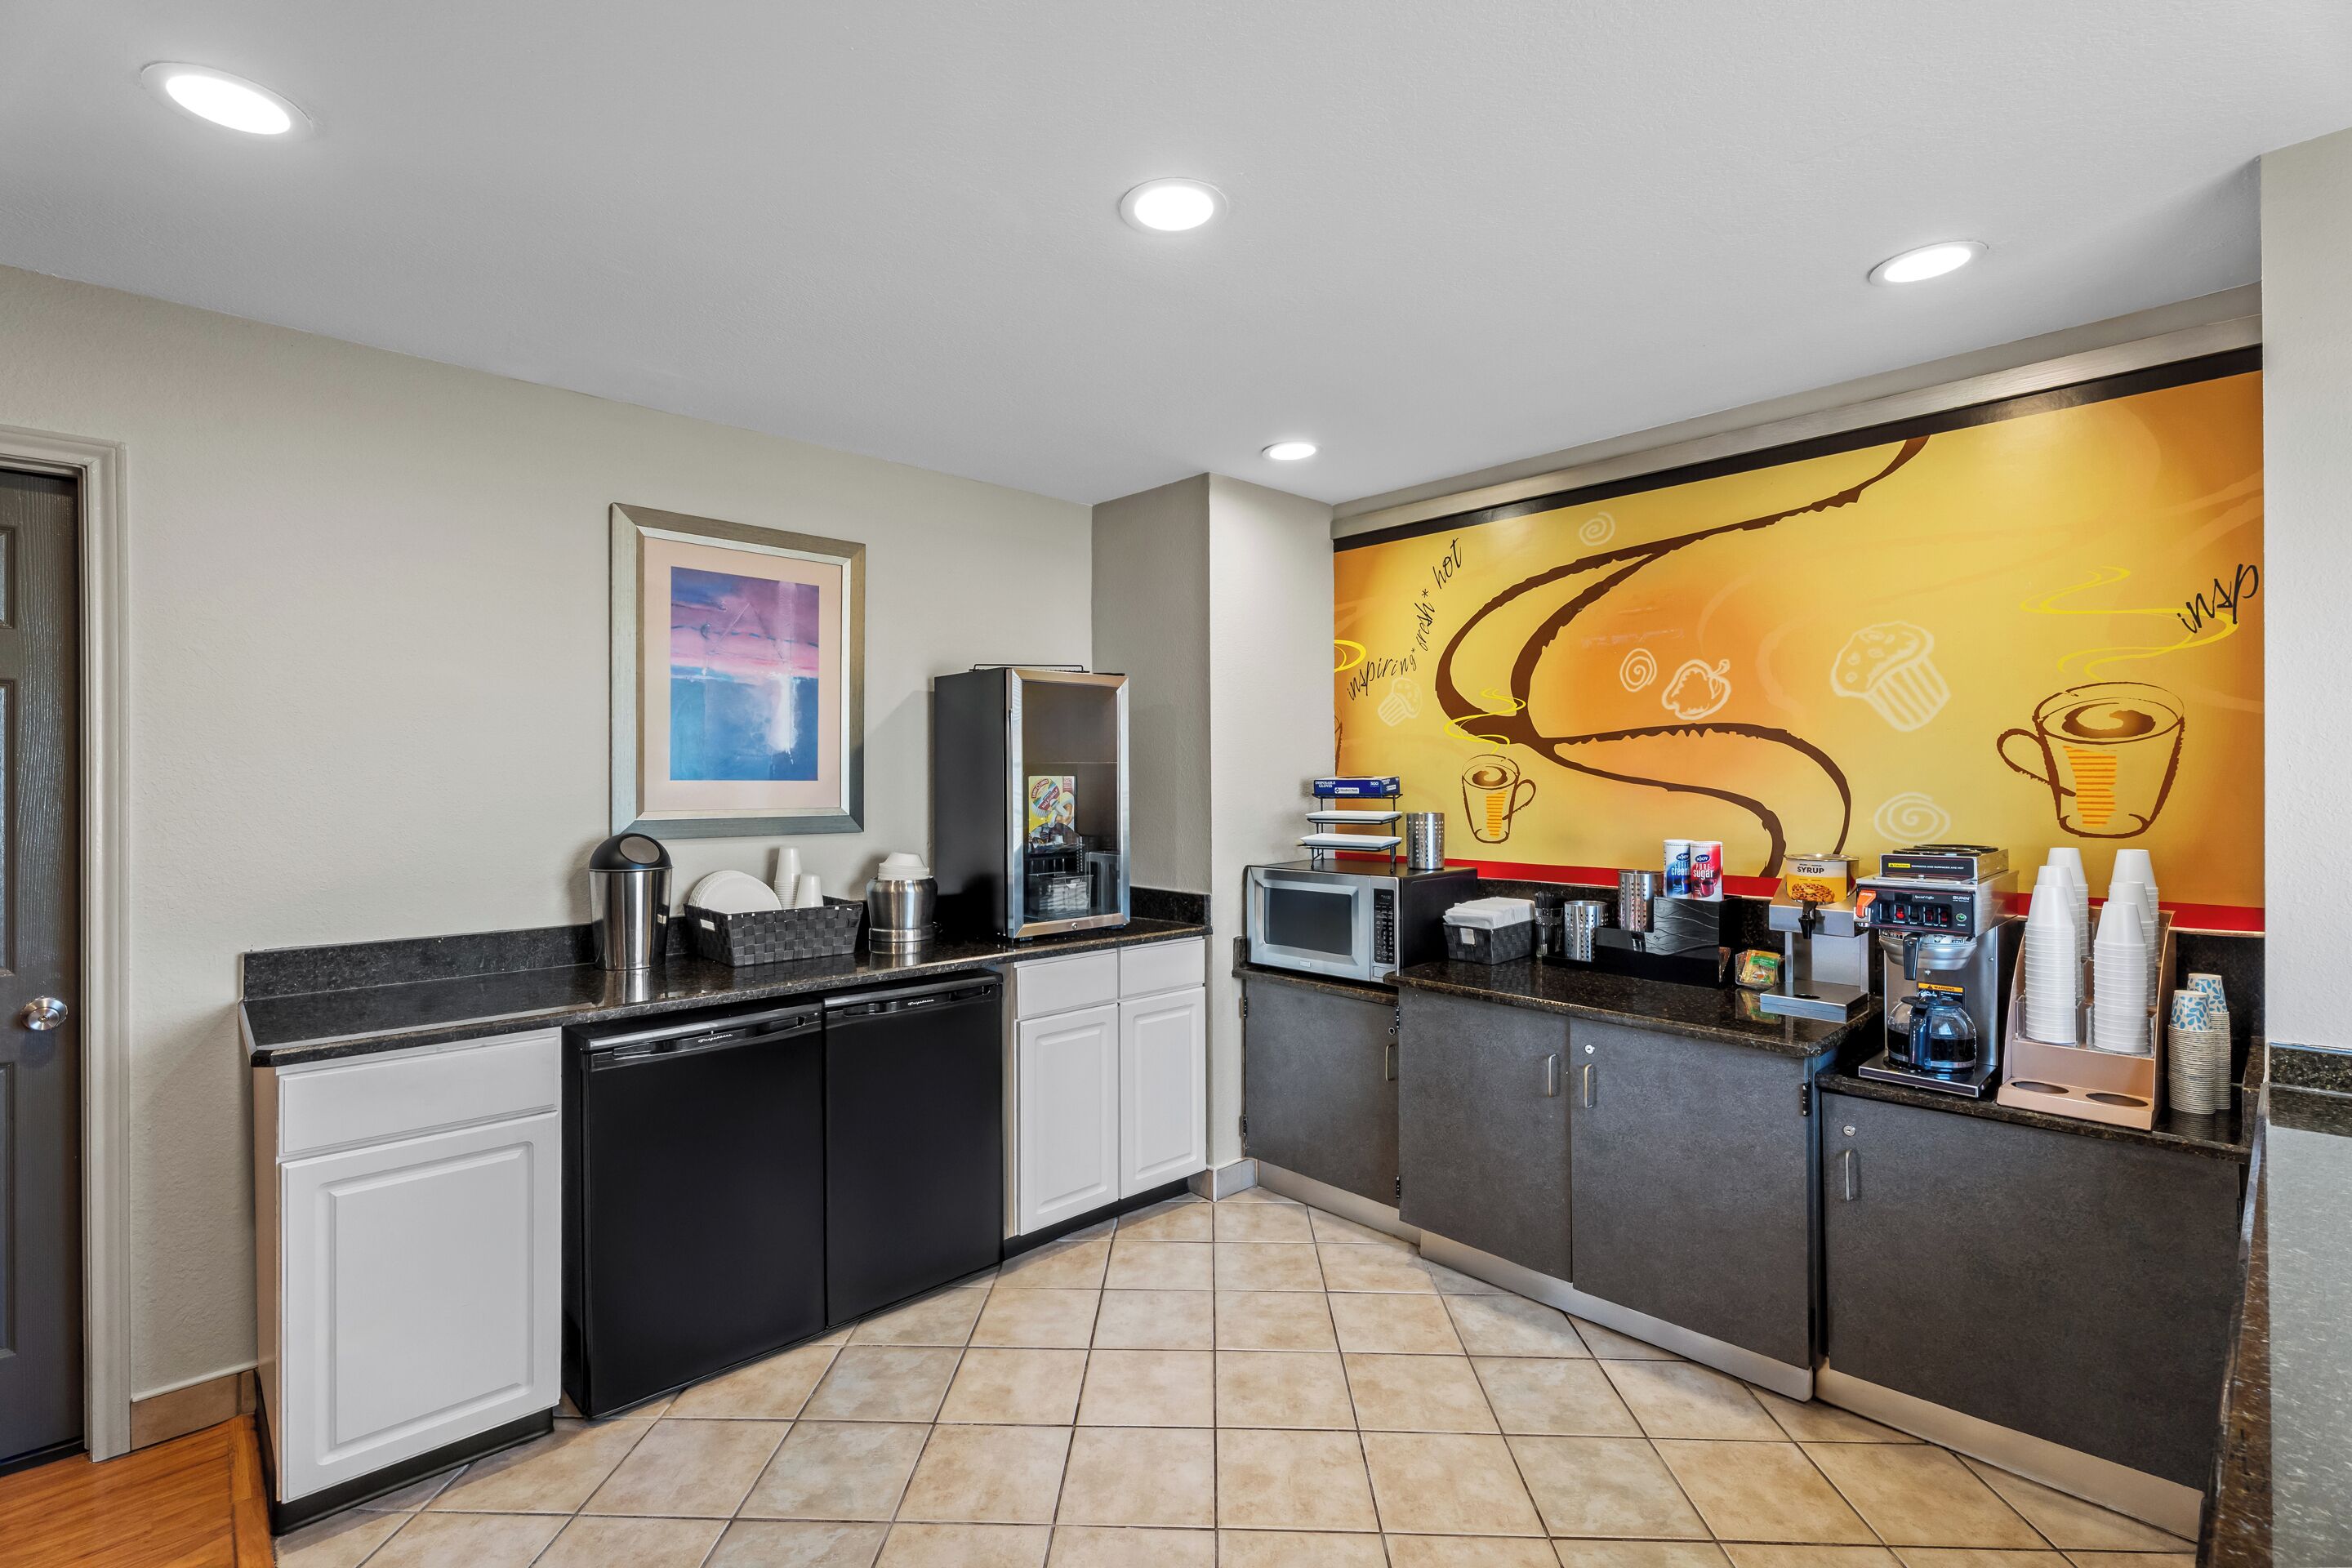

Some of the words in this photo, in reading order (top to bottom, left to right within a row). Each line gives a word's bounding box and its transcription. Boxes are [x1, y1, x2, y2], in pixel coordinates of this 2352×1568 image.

[1432, 537, 1462, 590] hot
[2176, 564, 2259, 634] insp
[1693, 870, 1714, 880] sugar
